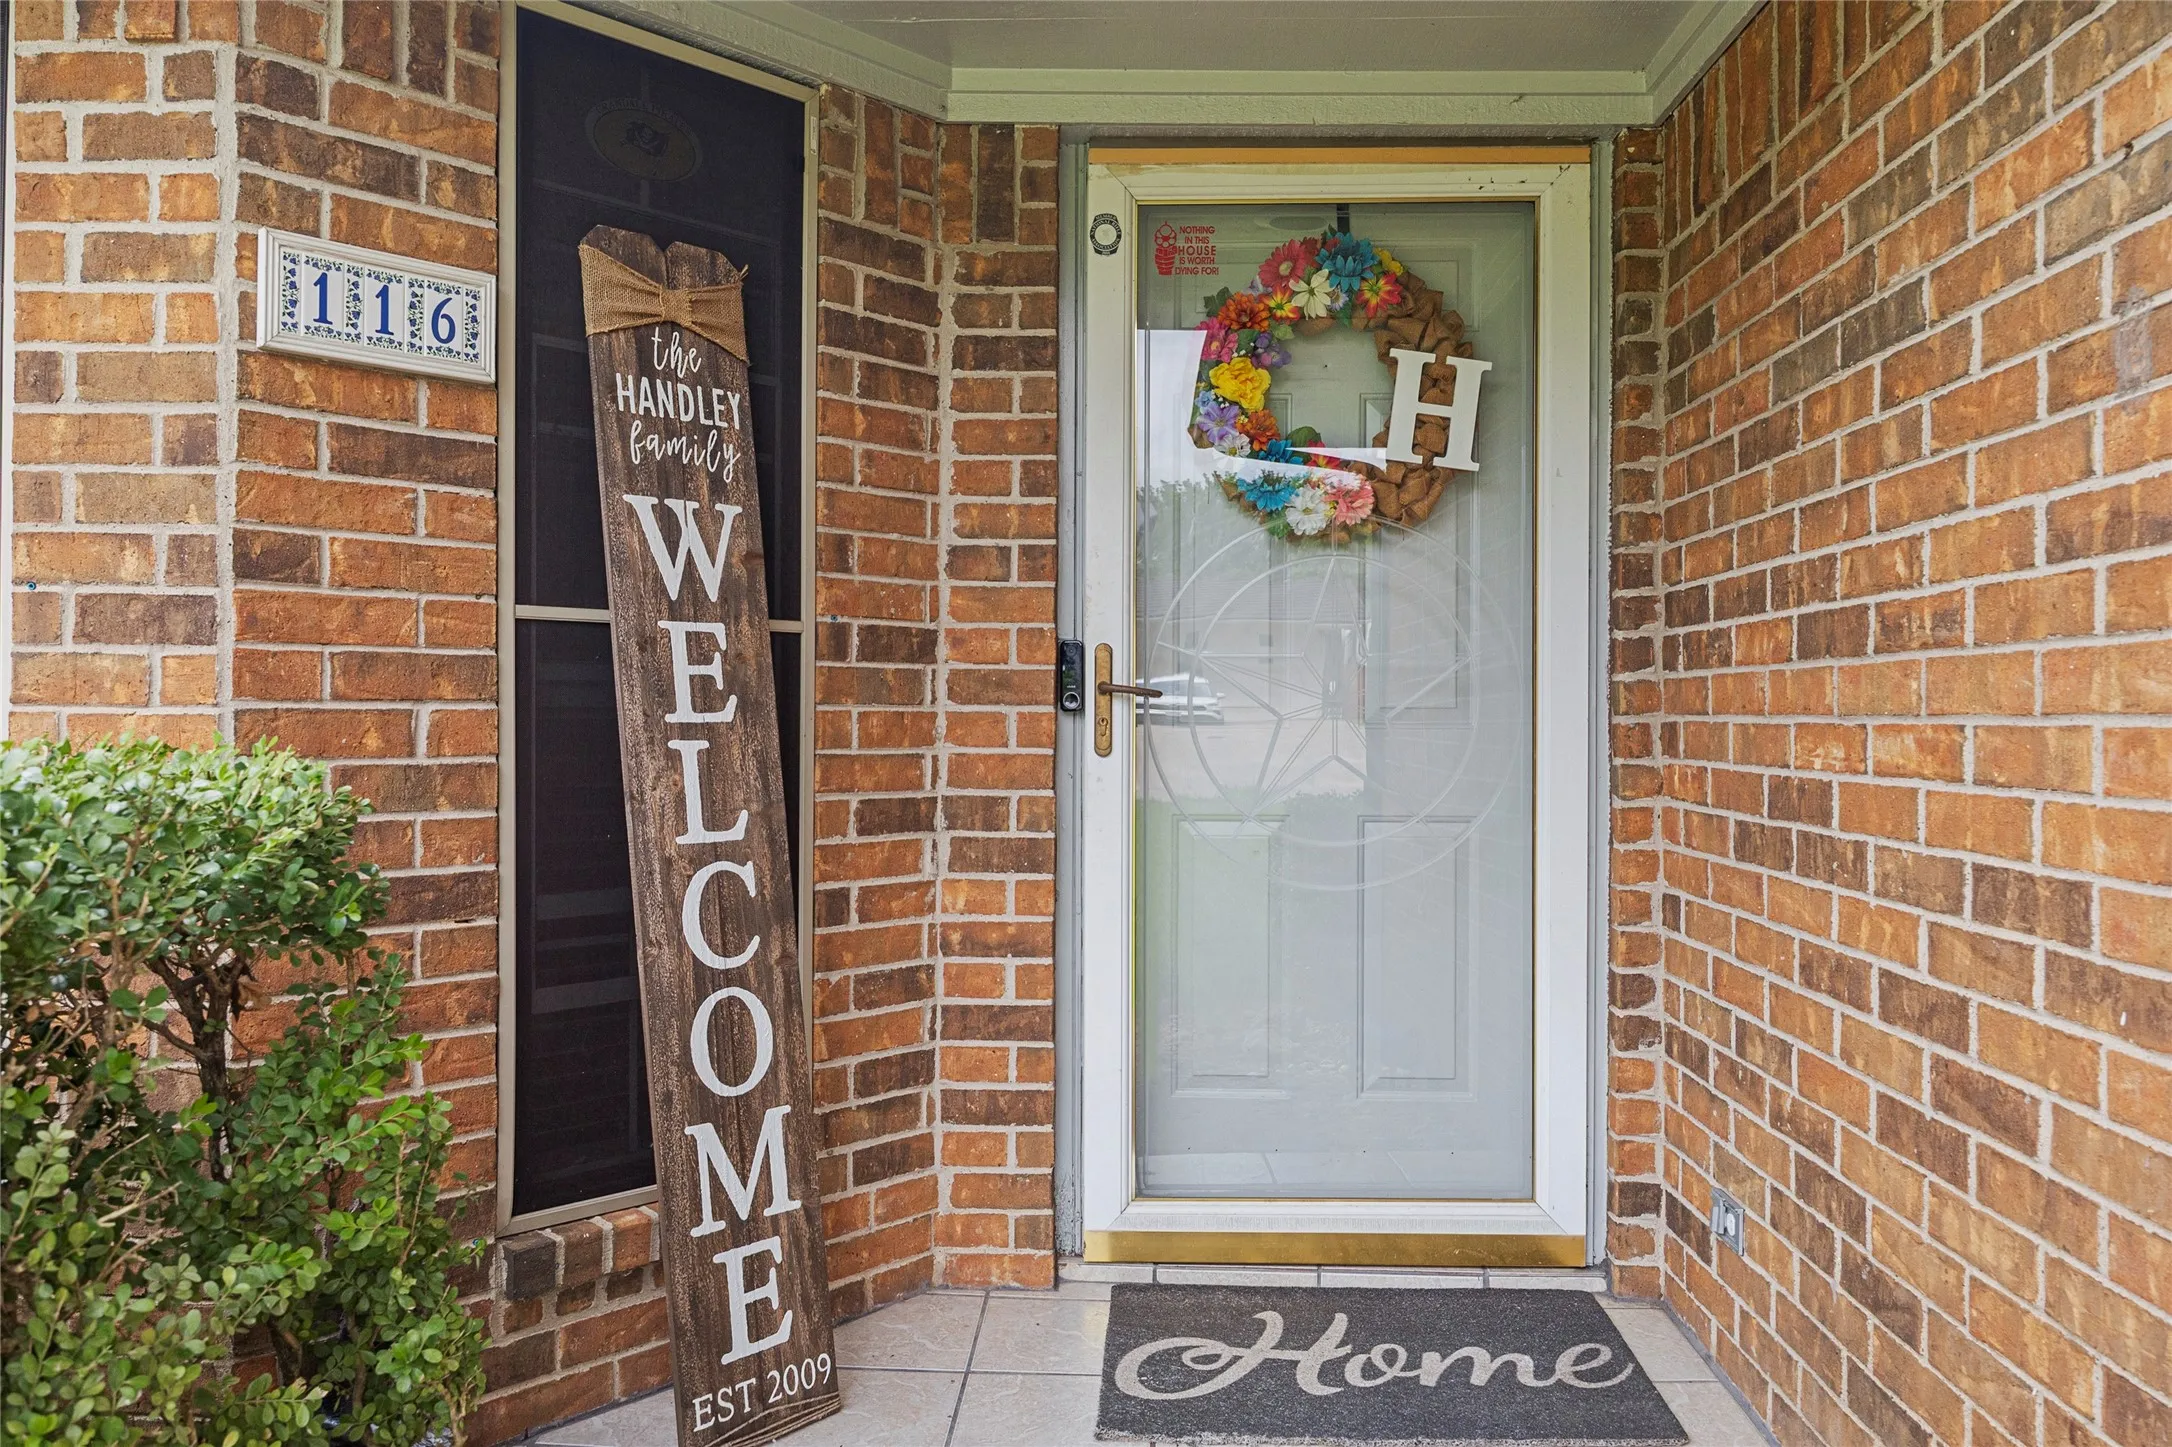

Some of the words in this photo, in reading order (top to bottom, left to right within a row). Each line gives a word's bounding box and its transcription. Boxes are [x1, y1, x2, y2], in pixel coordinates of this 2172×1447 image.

[1178, 245, 1216, 256] HOUSE
[1179, 225, 1215, 234] NOTHING
[1184, 236, 1192, 244] IN
[1194, 236, 1210, 244] THIS
[1175, 266, 1199, 275] DYING
[1201, 266, 1219, 275] FOR!
[1179, 256, 1186, 265] IS
[1187, 256, 1215, 265] WORTH
[313, 272, 456, 344] 116
[651, 326, 702, 378] the
[615, 372, 741, 430] HANDLEY
[1385, 347, 1493, 472] H
[629, 419, 741, 483] family
[622, 494, 802, 1366] WELCOME
[1114, 1310, 1634, 1400] Home
[692, 1376, 757, 1433] EST
[767, 1352, 832, 1404] 2009
